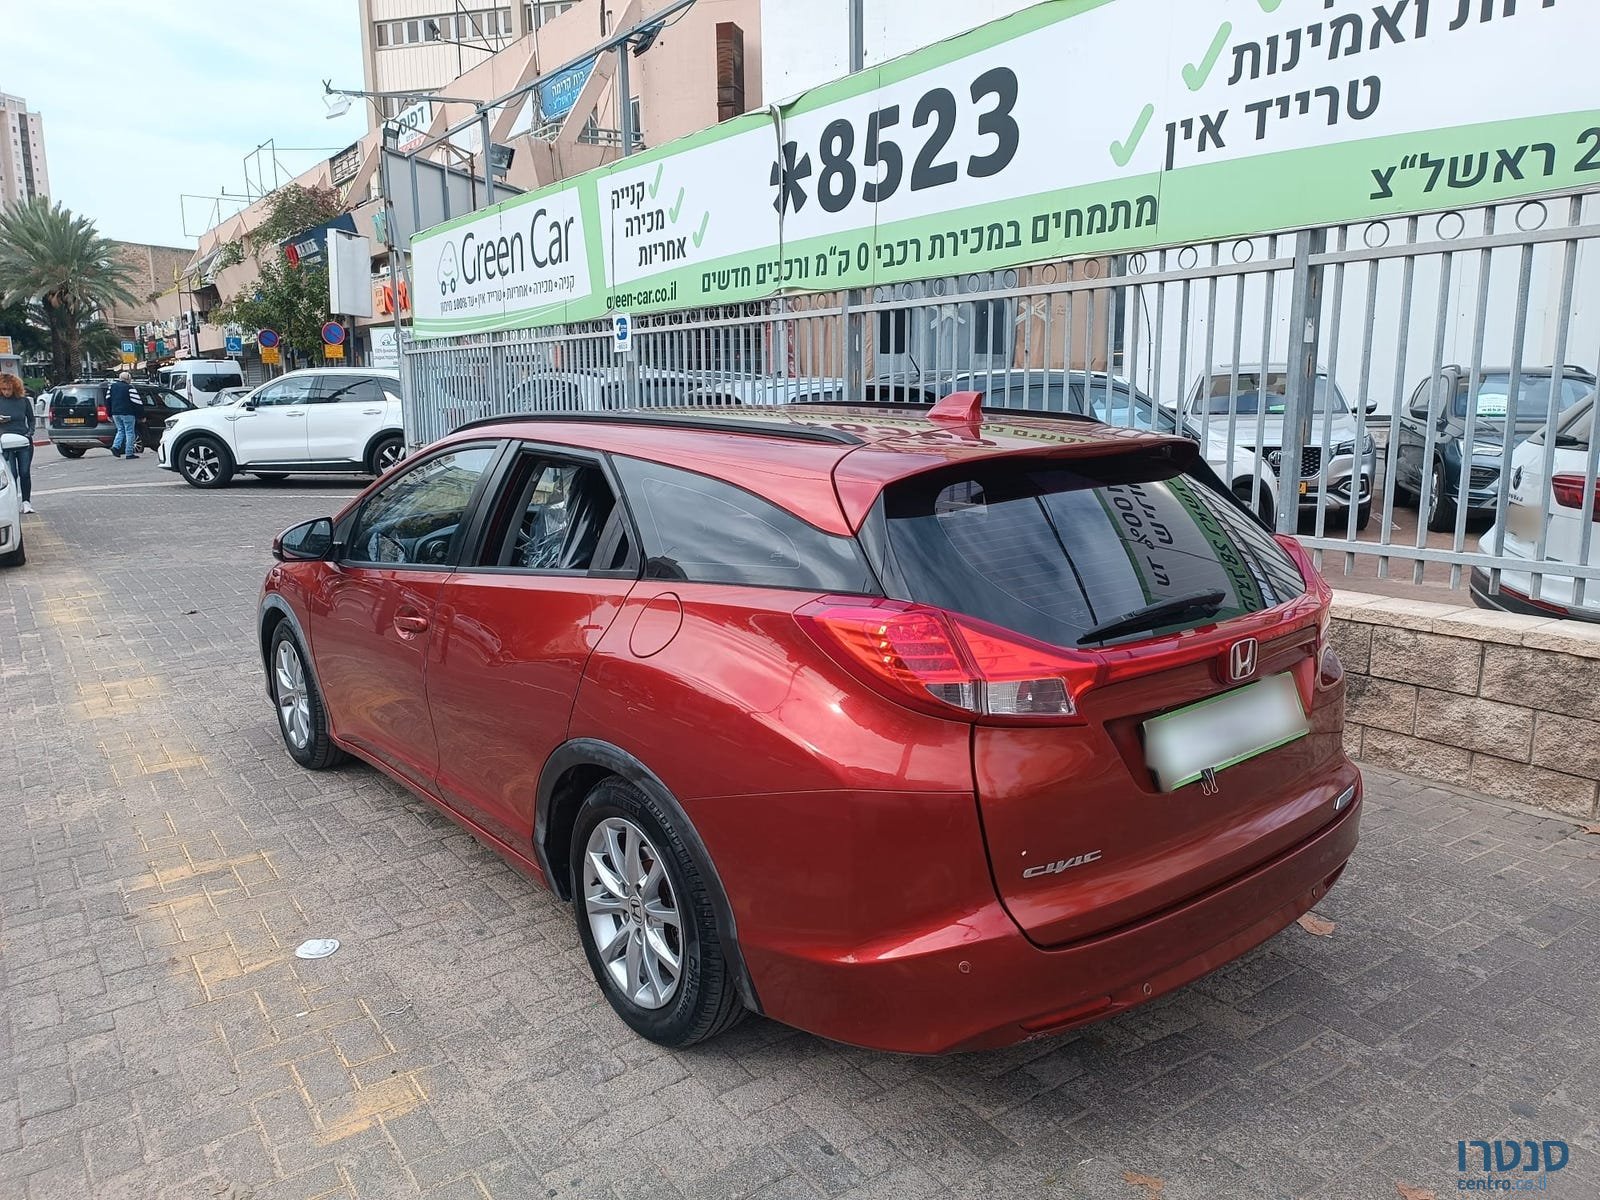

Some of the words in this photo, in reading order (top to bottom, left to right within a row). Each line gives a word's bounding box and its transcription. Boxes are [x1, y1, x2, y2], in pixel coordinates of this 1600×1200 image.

[1227, 0, 1431, 86] ואמינות
[1244, 75, 1382, 141] טרייד
[1165, 109, 1229, 171] אין
[611, 181, 645, 210] קנייה
[625, 208, 665, 238] מכירה
[1031, 194, 1158, 244] מתמחים
[462, 232, 524, 285] Green
[531, 208, 575, 269] Car
[638, 236, 687, 267] אחריות
[875, 238, 921, 268] רכבי
[927, 220, 1022, 261] במכירת
[756, 256, 809, 285] ורכבים
[857, 242, 869, 271] 0
[506, 284, 529, 300] אחריות
[533, 279, 553, 295] מכירה
[559, 275, 575, 293] קניה
[701, 266, 751, 293] חדשים
